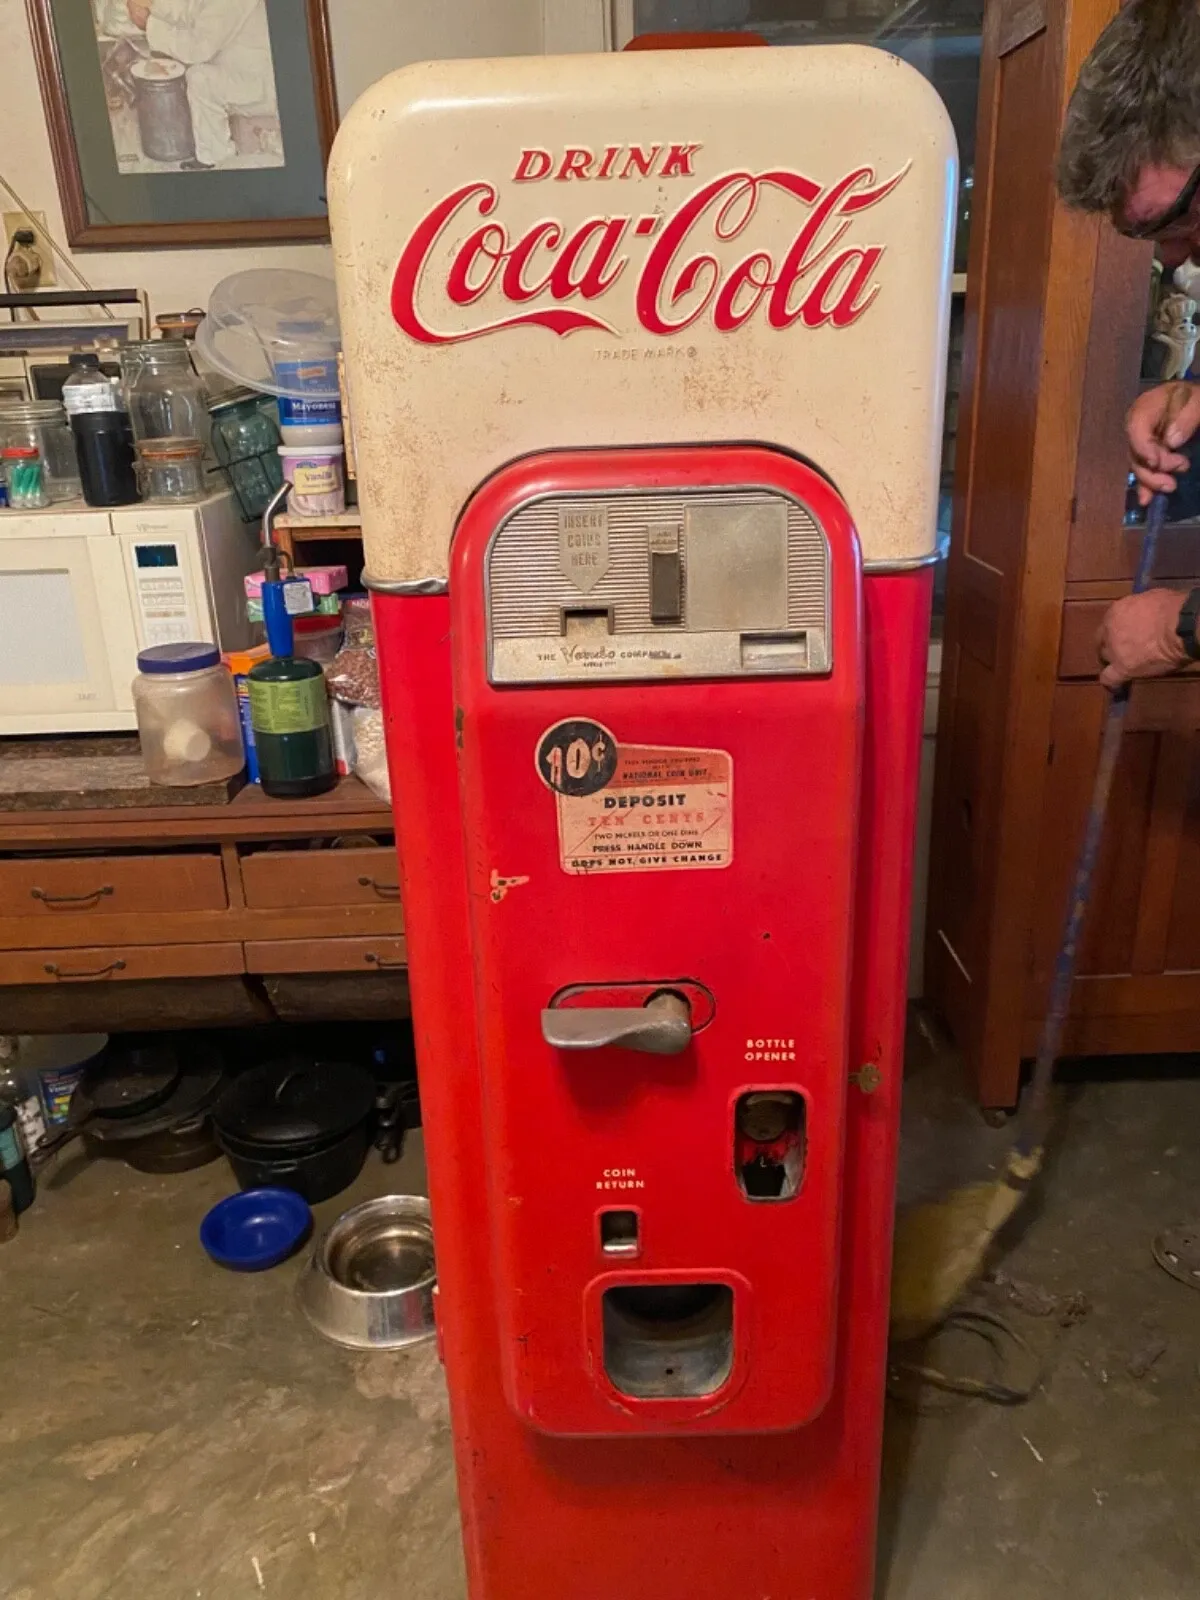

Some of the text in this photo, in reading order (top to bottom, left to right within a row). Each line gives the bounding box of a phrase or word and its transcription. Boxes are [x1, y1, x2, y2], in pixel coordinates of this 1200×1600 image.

[512, 142, 705, 182] DRINK
[391, 157, 914, 346] Coca-Cola
[594, 348, 638, 360] TRADE
[571, 552, 598, 566] HERE
[537, 653, 556, 661] THE
[604, 794, 687, 809] DEPOSIT
[588, 813, 705, 826] TEN CENTS
[592, 841, 703, 853] PRESS HANDLE DOWN
[639, 856, 668, 865] GIVE
[673, 853, 723, 863] CHANGE
[746, 1039, 795, 1049] BOTTLE
[744, 1051, 796, 1062] OPENER
[603, 1168, 636, 1178] COIN
[596, 1180, 645, 1190] RETURN
